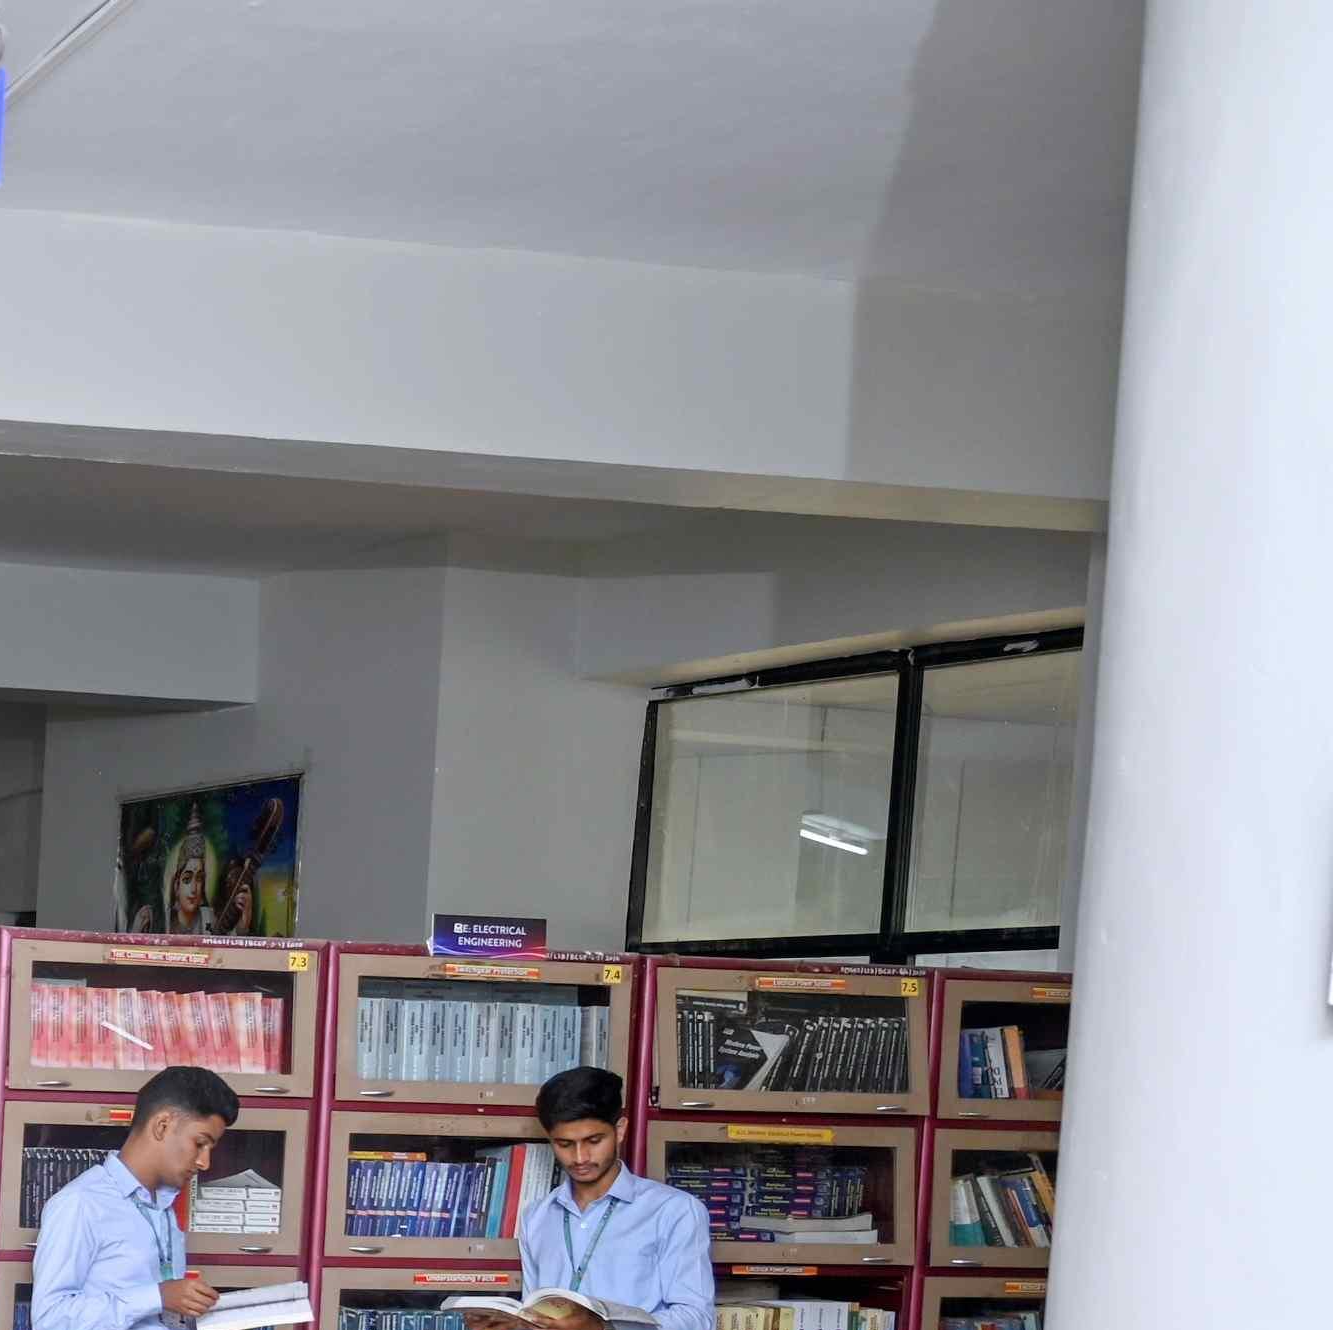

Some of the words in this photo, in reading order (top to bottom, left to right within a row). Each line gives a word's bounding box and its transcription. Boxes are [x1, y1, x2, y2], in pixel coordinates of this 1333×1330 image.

[474, 924, 527, 937] ELECTRICAL
[458, 937, 513, 949] ENGINEERING
[291, 956, 307, 968] 7.3
[604, 969, 620, 981] 7.4
[902, 982, 917, 993] 7.5
